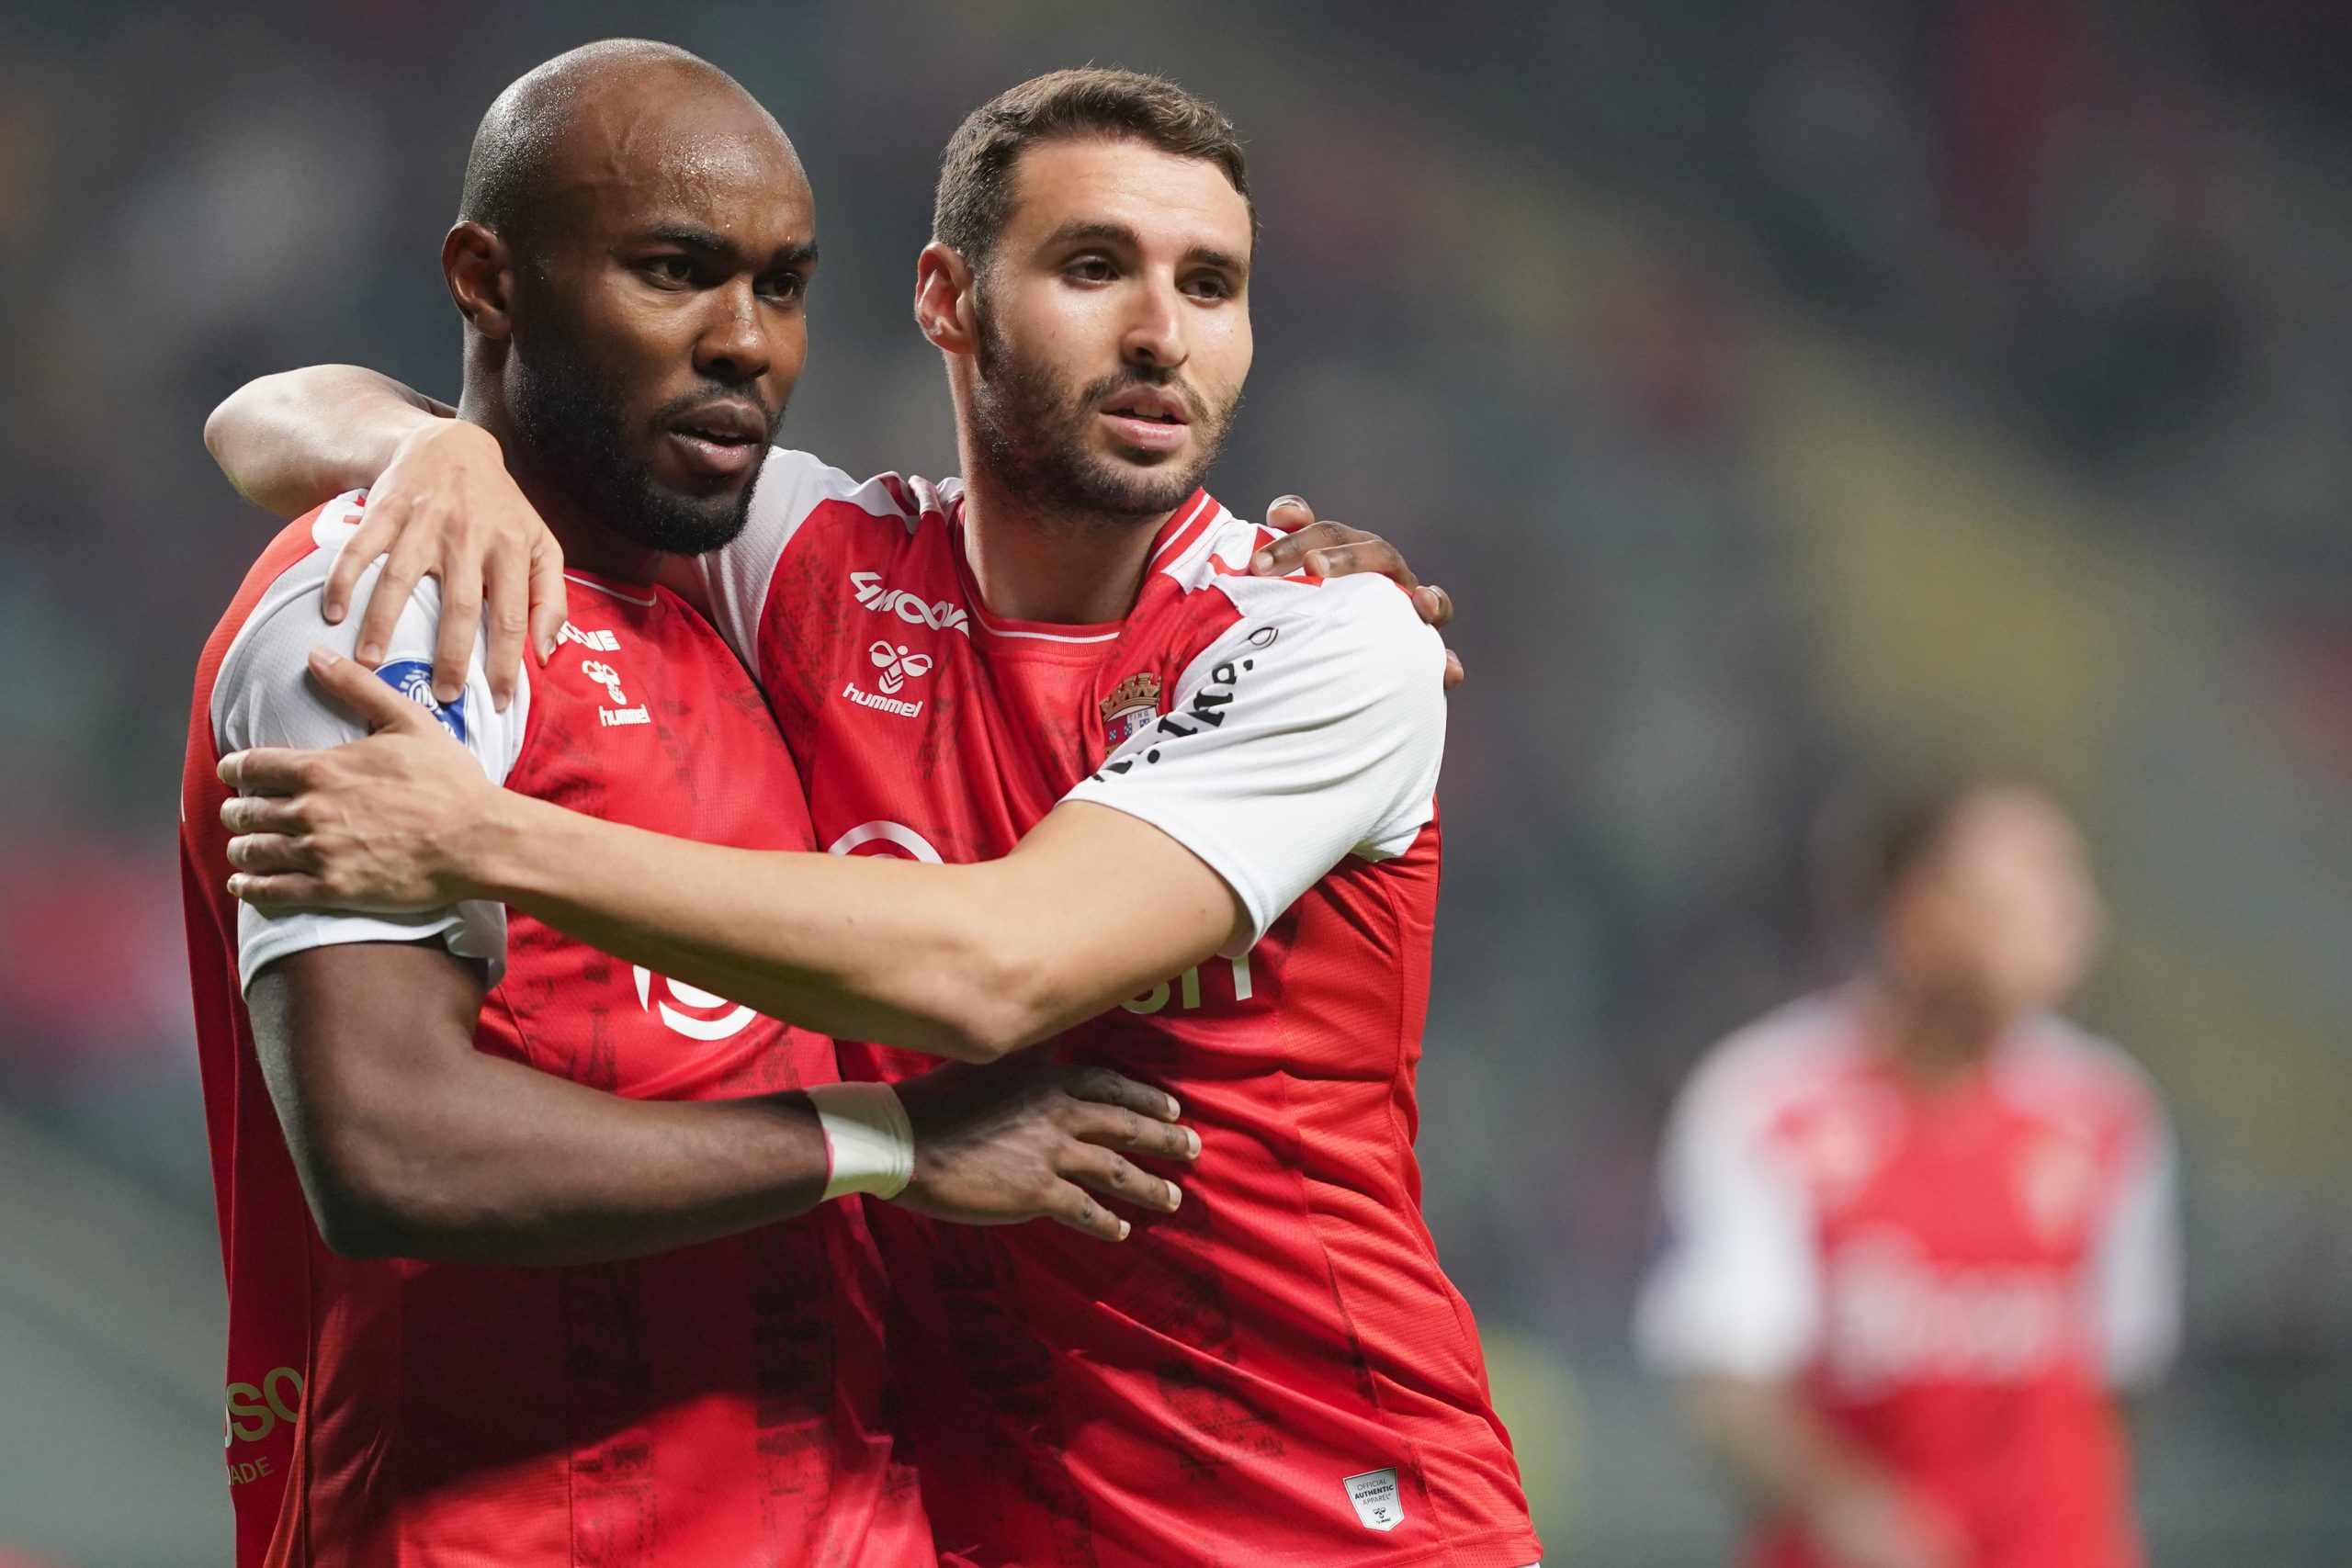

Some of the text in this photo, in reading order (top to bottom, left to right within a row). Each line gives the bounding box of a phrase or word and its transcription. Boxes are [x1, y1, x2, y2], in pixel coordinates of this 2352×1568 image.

[842, 682, 923, 718] hummel
[598, 703, 651, 728] hummel
[1354, 1484, 1395, 1500] AUTHENTIC
[1356, 1478, 1387, 1491] OFFICIAL
